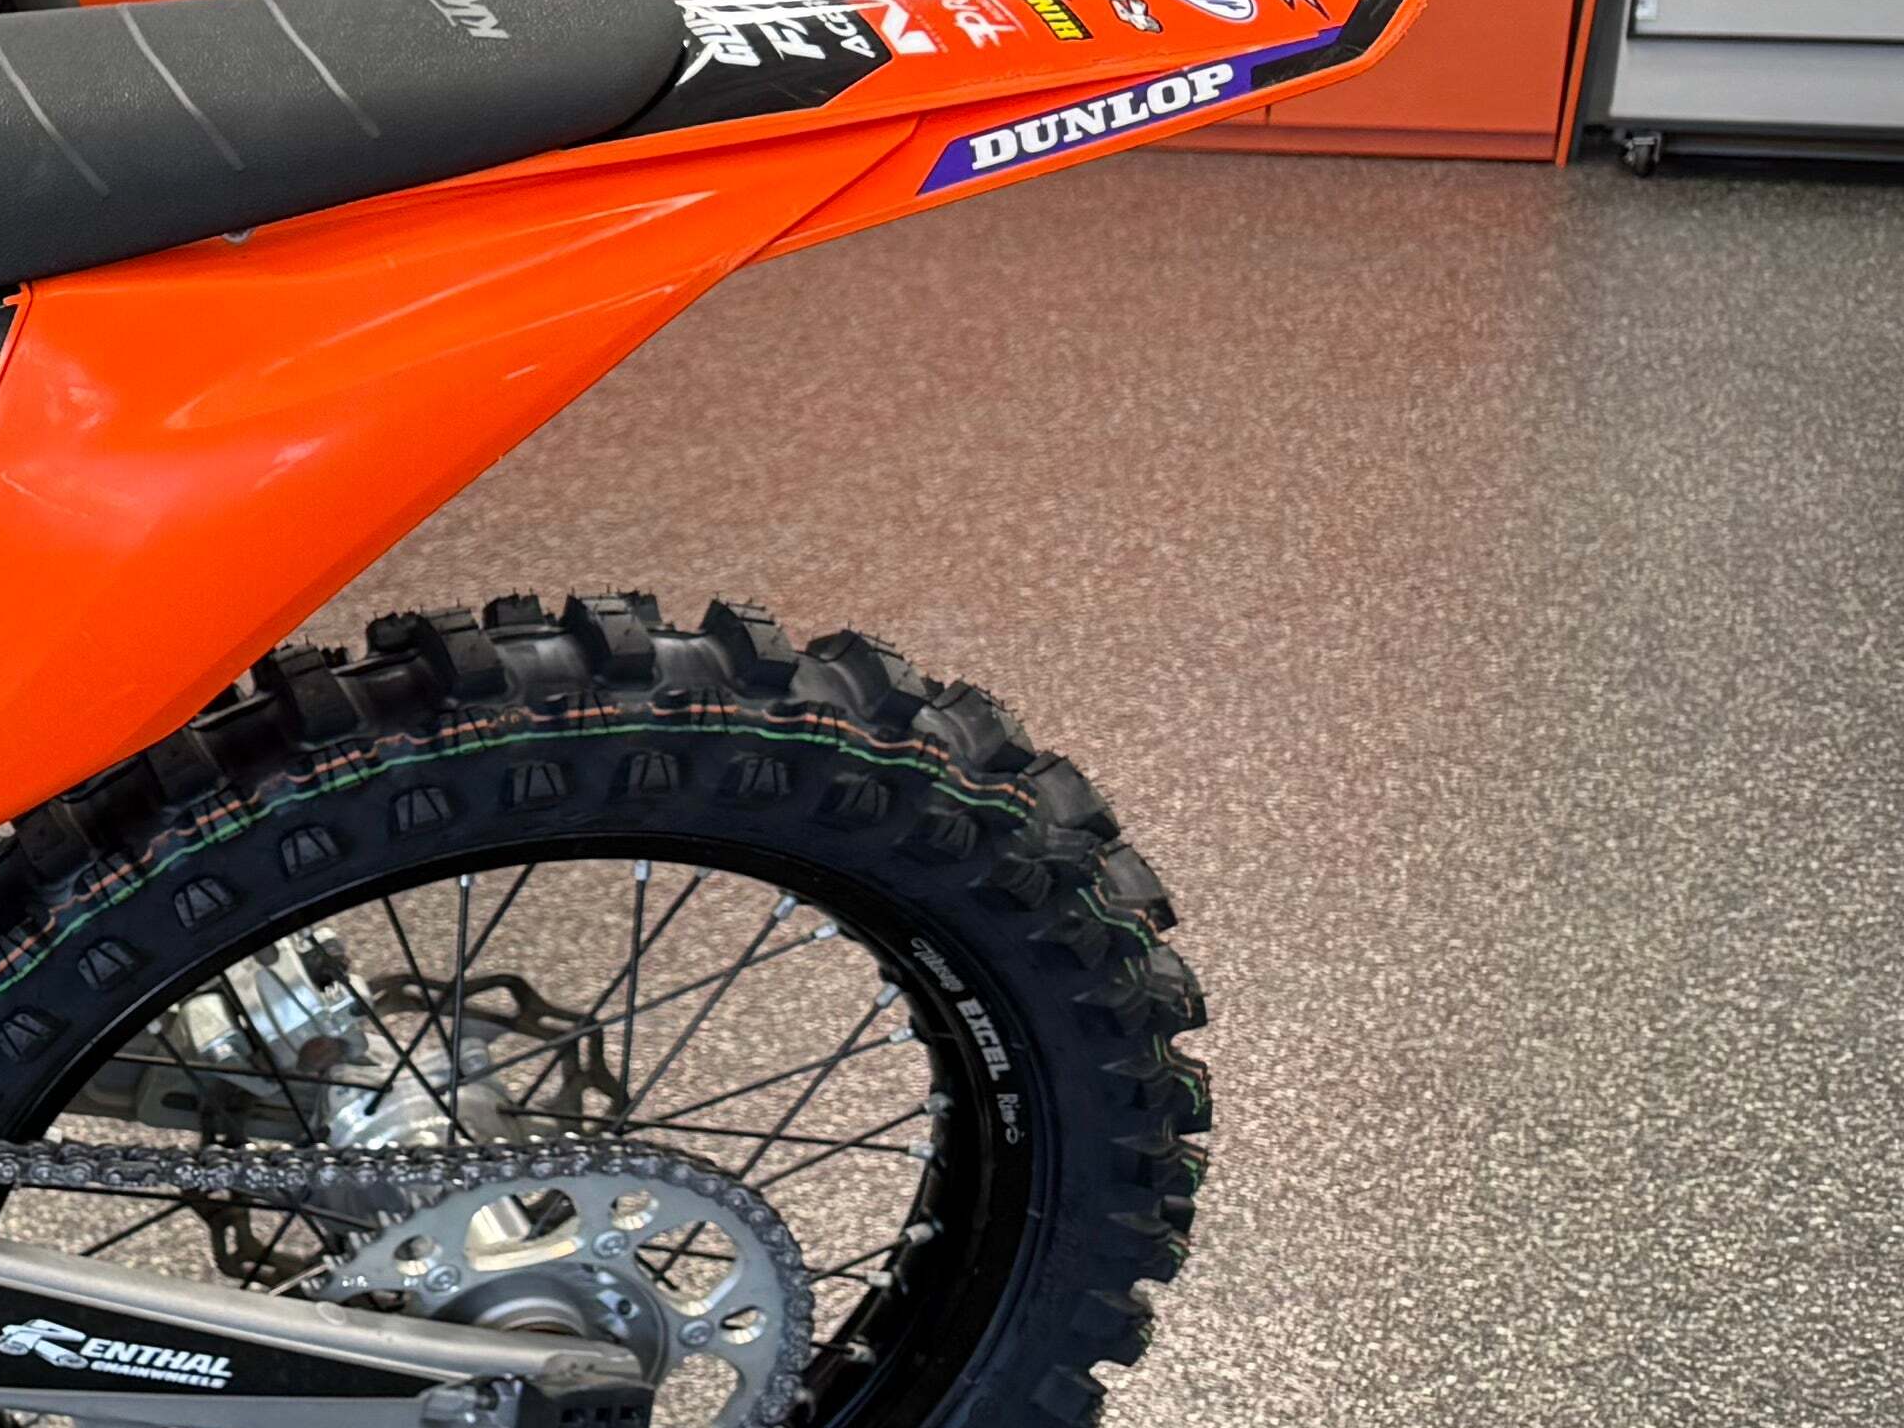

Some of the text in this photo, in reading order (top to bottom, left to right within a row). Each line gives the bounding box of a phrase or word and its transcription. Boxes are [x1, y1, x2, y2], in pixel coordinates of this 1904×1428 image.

[969, 63, 1234, 171] DUNLOP
[956, 995, 1012, 1082] EXCEL
[89, 1360, 227, 1389] CHAINWHEELS
